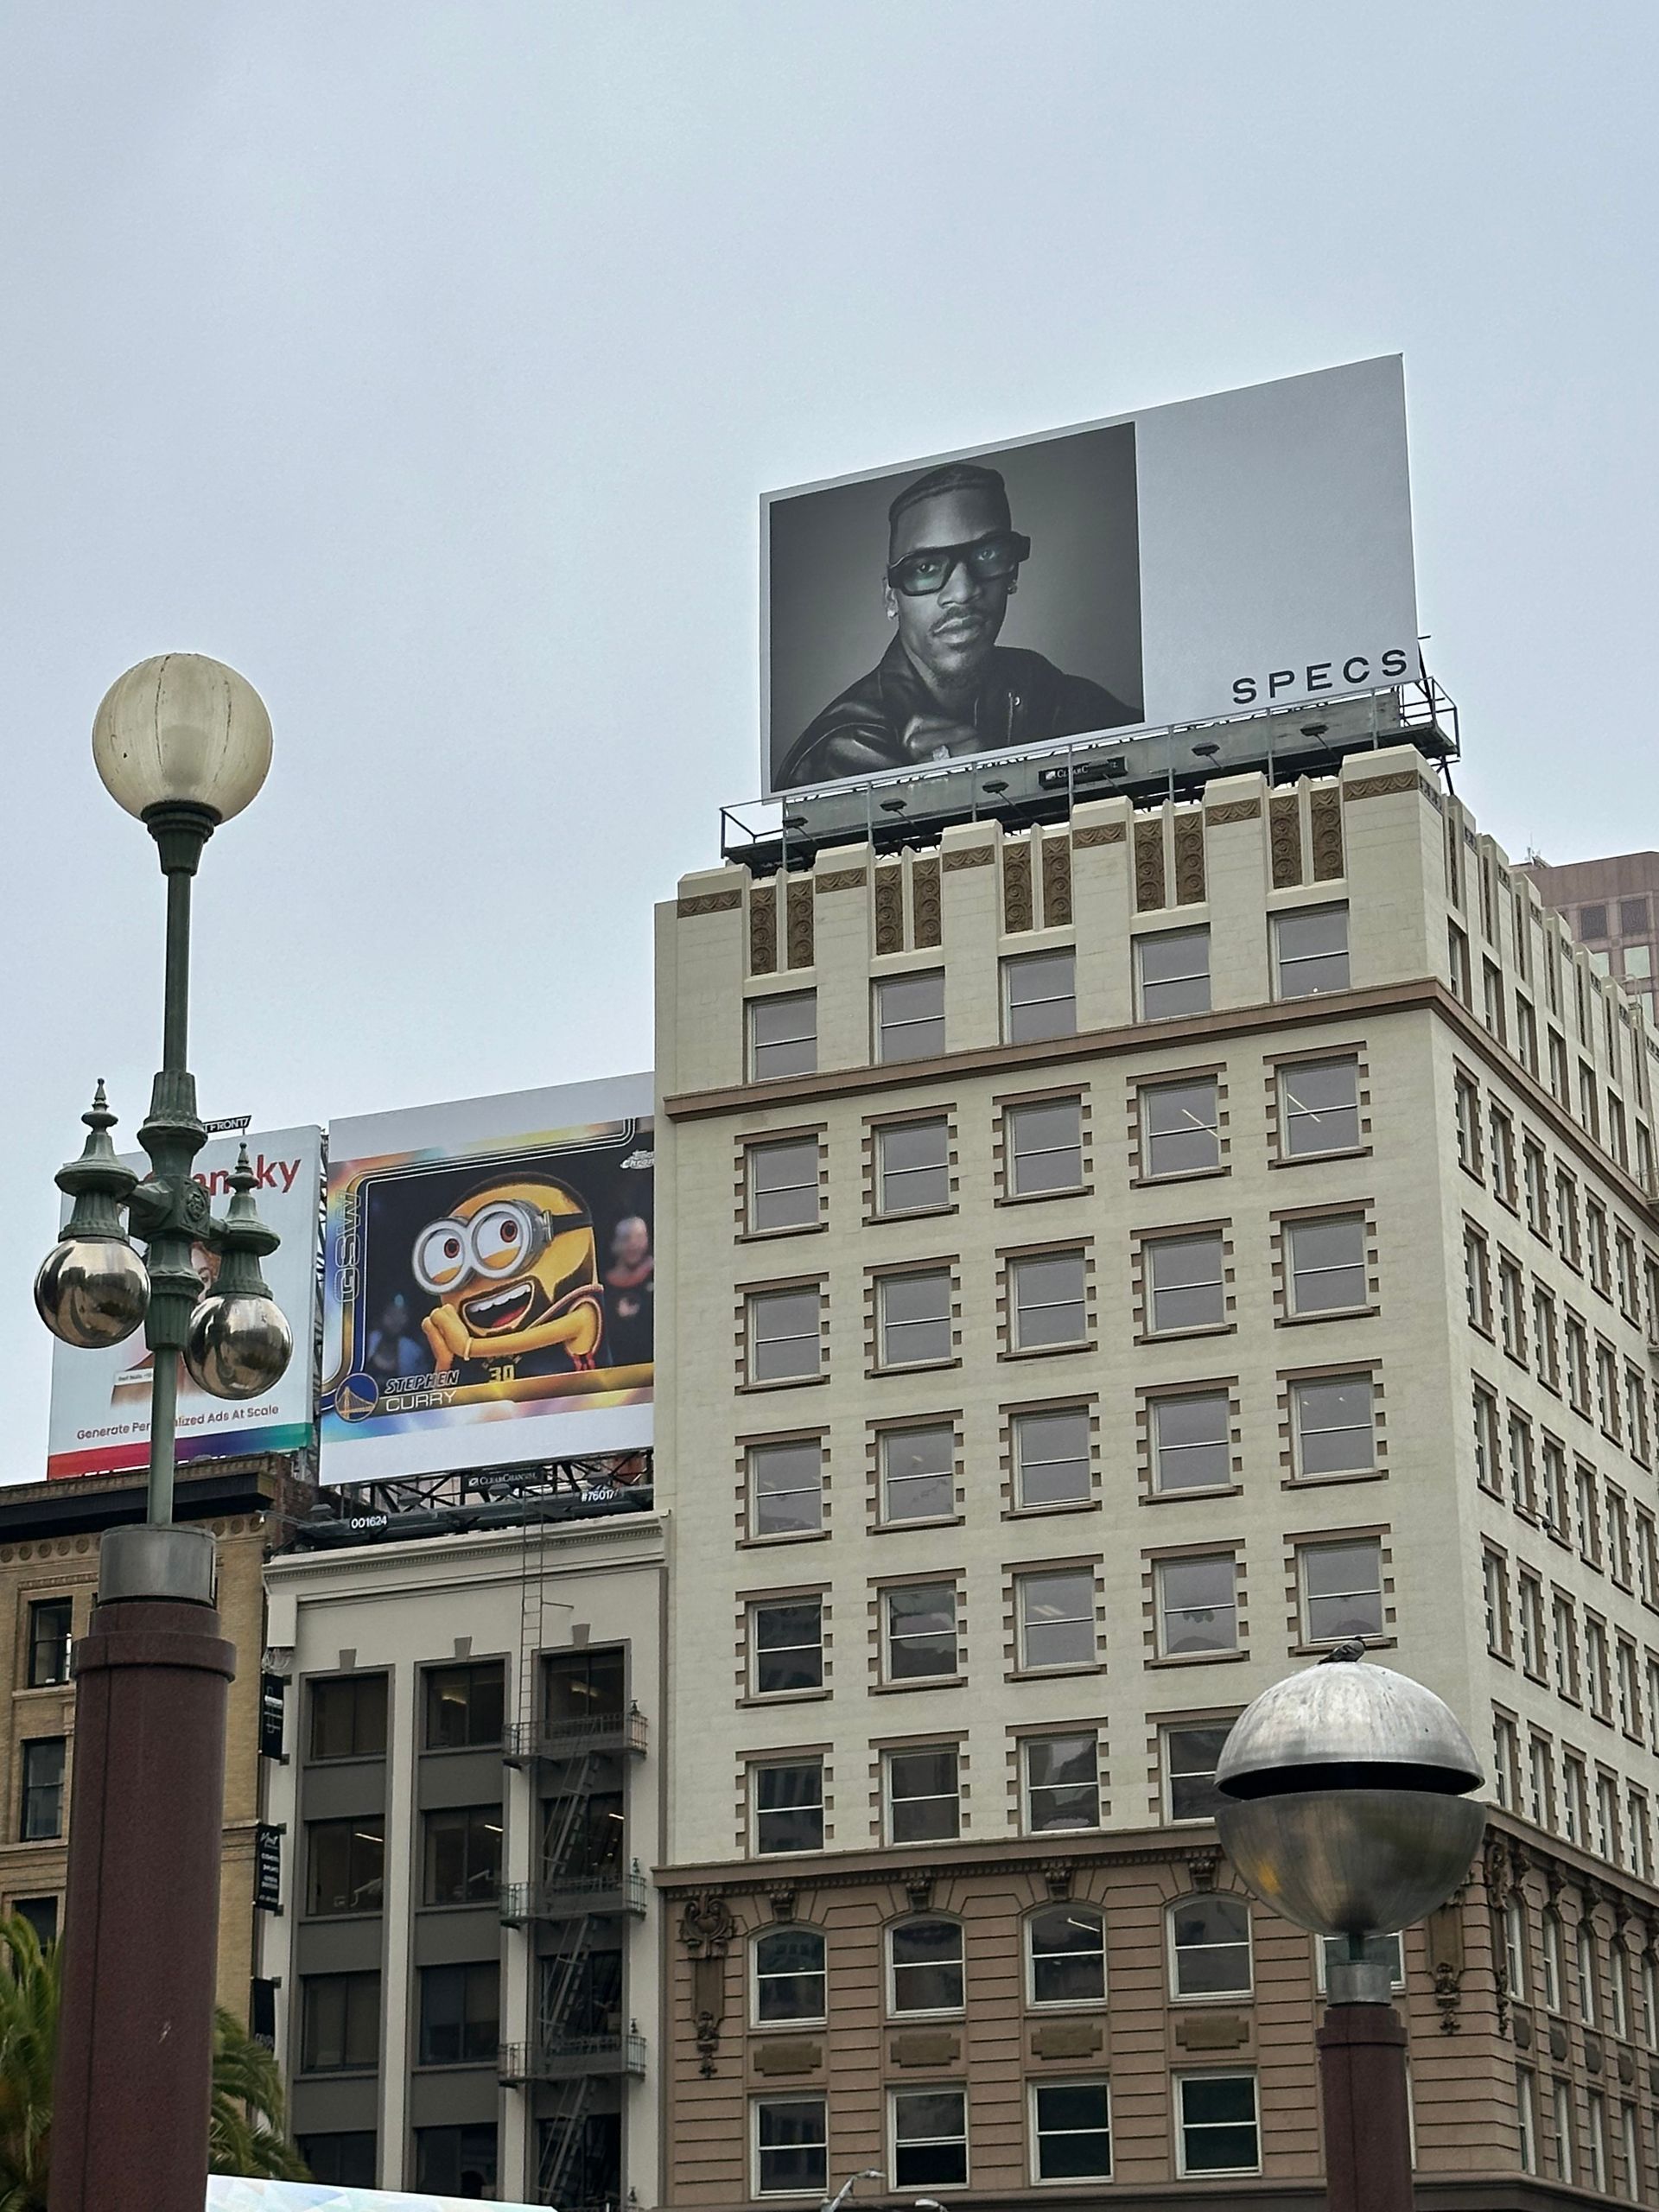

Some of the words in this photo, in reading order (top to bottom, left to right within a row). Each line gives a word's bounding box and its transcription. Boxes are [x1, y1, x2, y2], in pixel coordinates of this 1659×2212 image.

[1232, 649, 1407, 704] SPECS
[334, 1189, 361, 1303] GSW
[385, 1370, 460, 1394] STEPHEN
[488, 1364, 515, 1382] 30
[386, 1390, 457, 1412] CURRY
[77, 1424, 130, 1440] Generate
[207, 1411, 230, 1423] Ads
[232, 1409, 245, 1420] At
[247, 1404, 279, 1418] Scale
[351, 1515, 387, 1529] 001624
